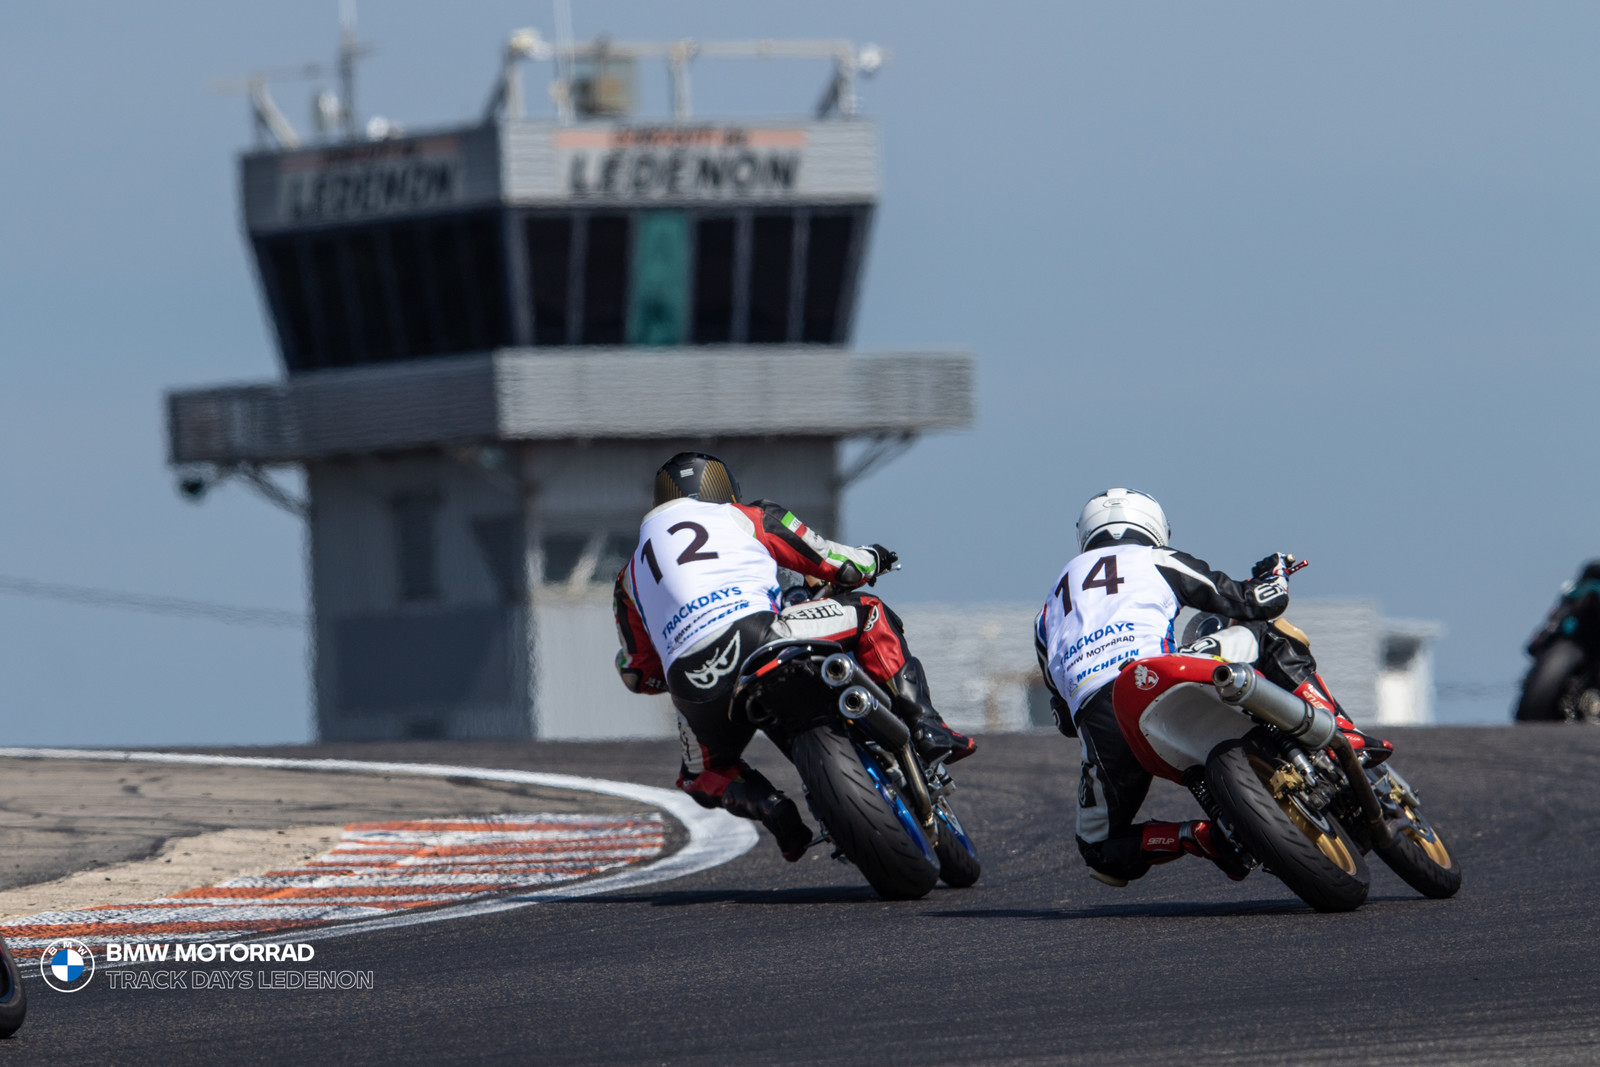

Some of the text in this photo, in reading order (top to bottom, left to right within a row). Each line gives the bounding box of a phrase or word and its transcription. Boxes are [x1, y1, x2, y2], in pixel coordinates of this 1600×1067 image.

[641, 521, 719, 584] 12
[1055, 555, 1125, 617] 14
[662, 586, 742, 640] TRACKDAYS
[1061, 622, 1135, 664] RACKDAYS
[1076, 648, 1139, 682] MICHELIN
[1147, 837, 1175, 846] SETUP
